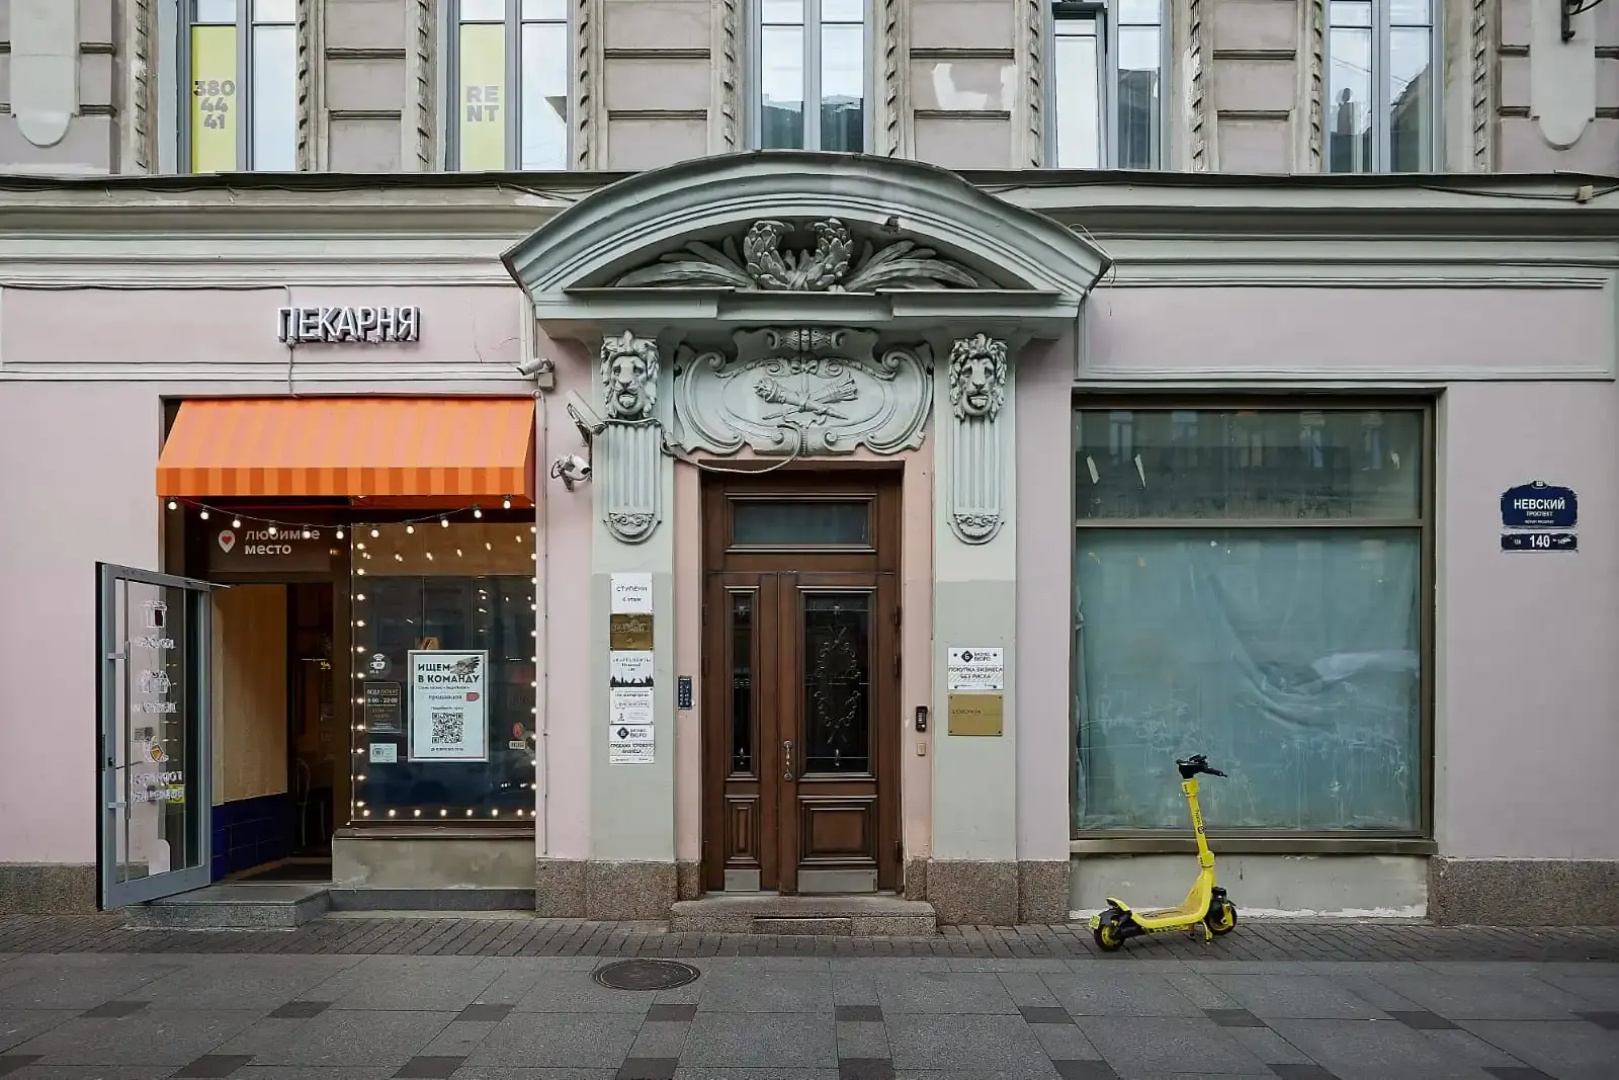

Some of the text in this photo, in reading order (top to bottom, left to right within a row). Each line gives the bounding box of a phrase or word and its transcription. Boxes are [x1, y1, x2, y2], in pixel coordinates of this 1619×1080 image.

[193, 80, 235, 97] 380
[466, 86, 499, 102] RE
[200, 97, 228, 112] 44
[466, 105, 499, 121] NT
[204, 114, 225, 129] 41
[277, 306, 421, 343] ПЕКАРНЯ
[1514, 497, 1565, 510] НЕВСКИЙ
[245, 528, 320, 541] любиме
[1529, 534, 1550, 548] 140
[245, 544, 291, 555] место
[418, 663, 450, 672] ИЩЕМ
[418, 674, 480, 683] В КОМАНДУ
